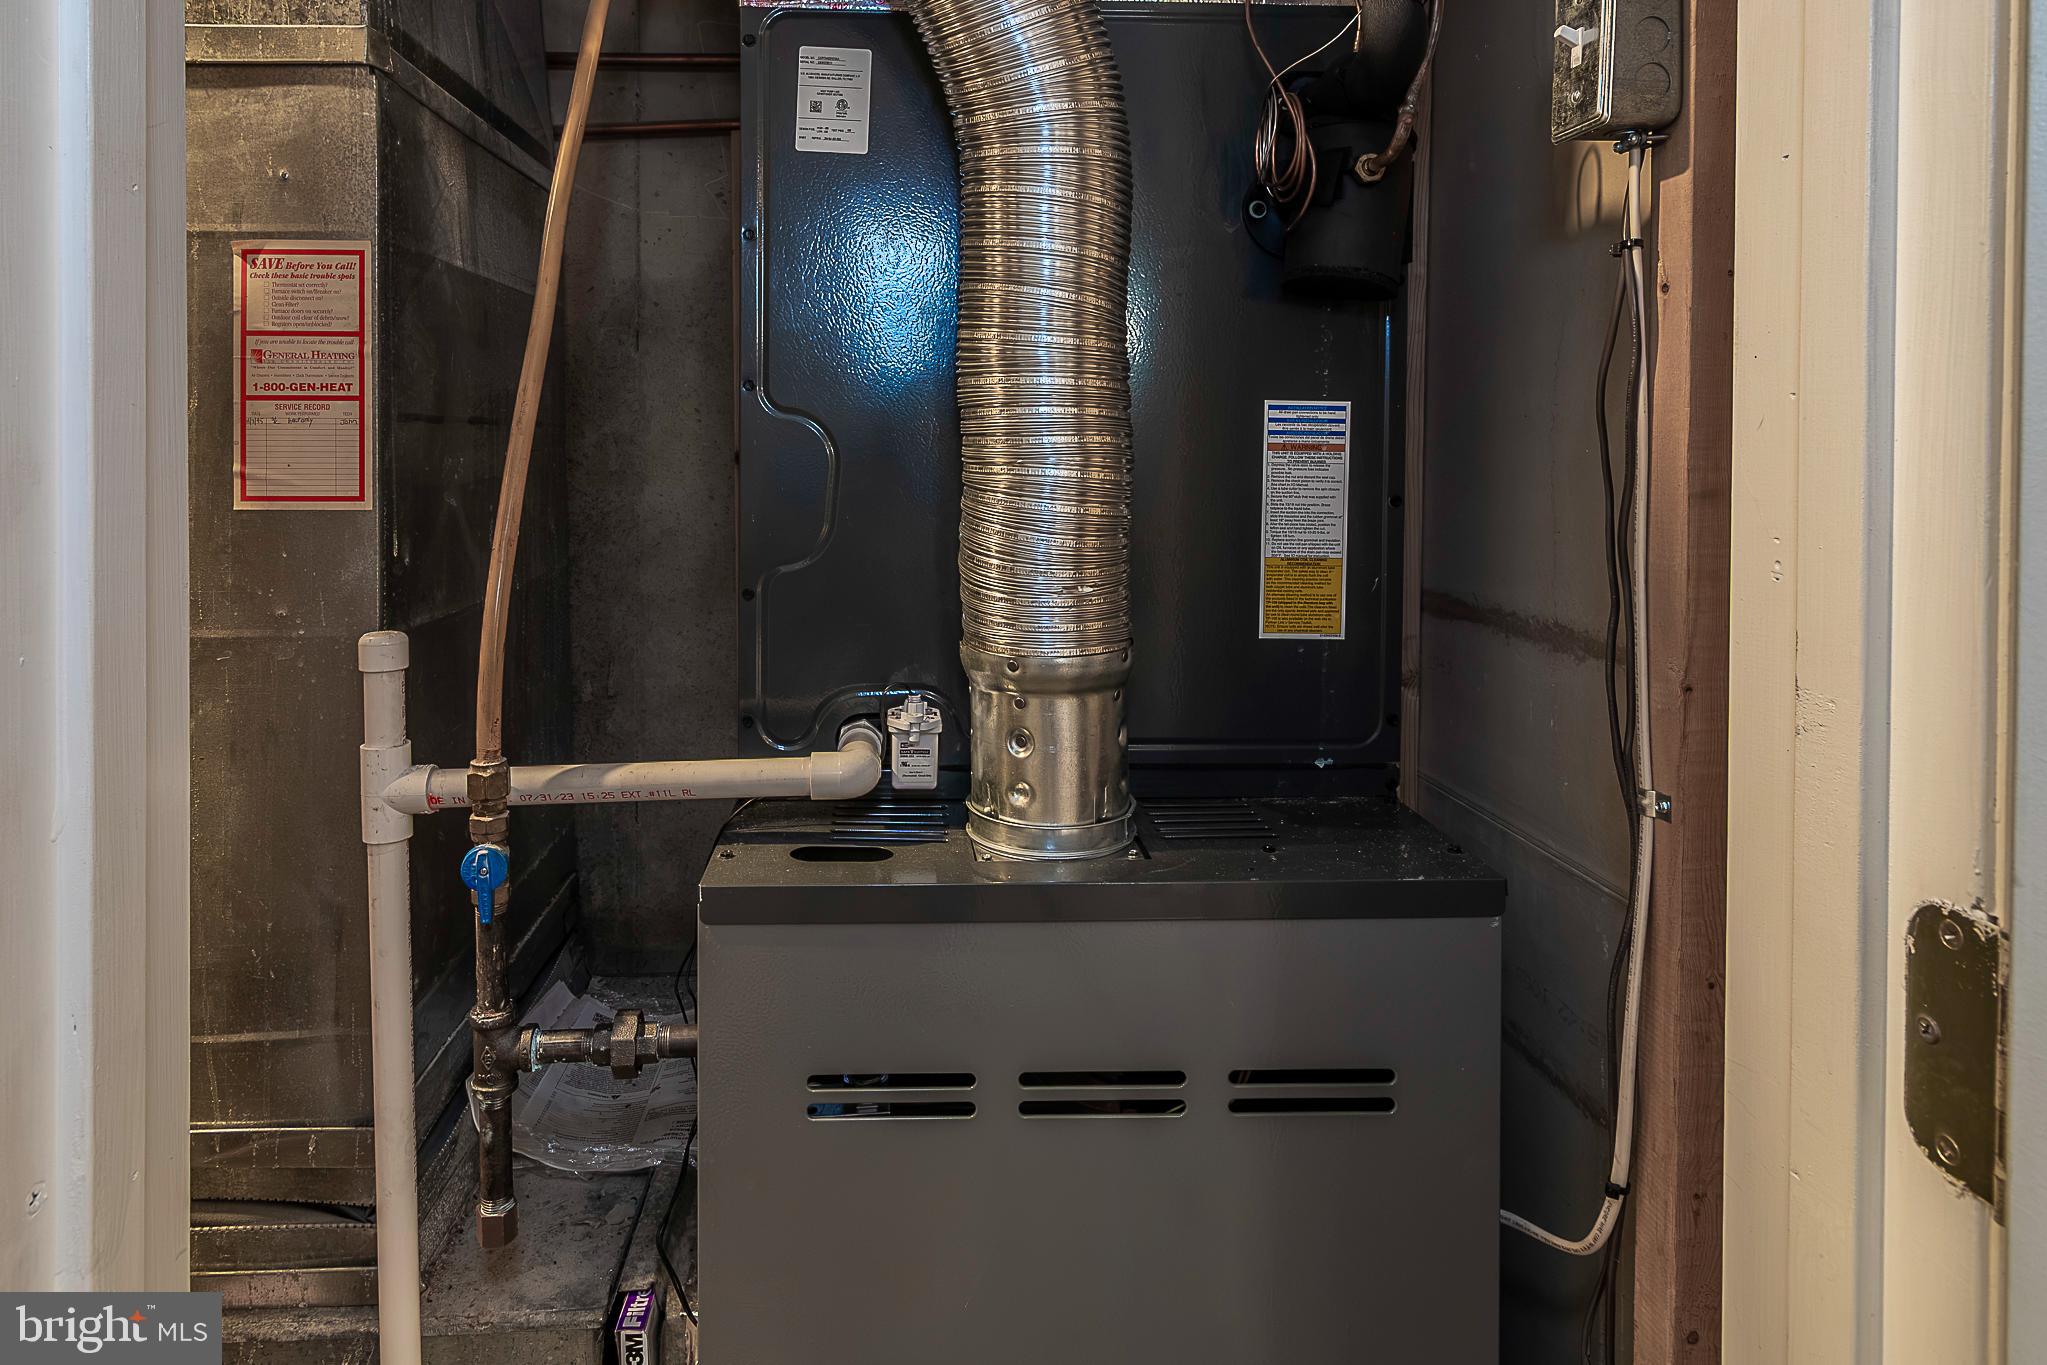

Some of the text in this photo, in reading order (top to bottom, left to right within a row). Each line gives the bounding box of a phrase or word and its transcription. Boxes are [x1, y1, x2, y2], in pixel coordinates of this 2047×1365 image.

[250, 258, 356, 271] SAVE Before You Call!
[264, 350, 355, 360] GENERAL HEATING
[253, 382, 353, 392] 1-800-GEN-HEAT
[520, 792, 574, 802] 07/31/23
[582, 792, 615, 800] 15:25
[621, 790, 641, 798] EXT
[682, 788, 696, 797] RL
[625, 1334, 644, 1365] 3M
